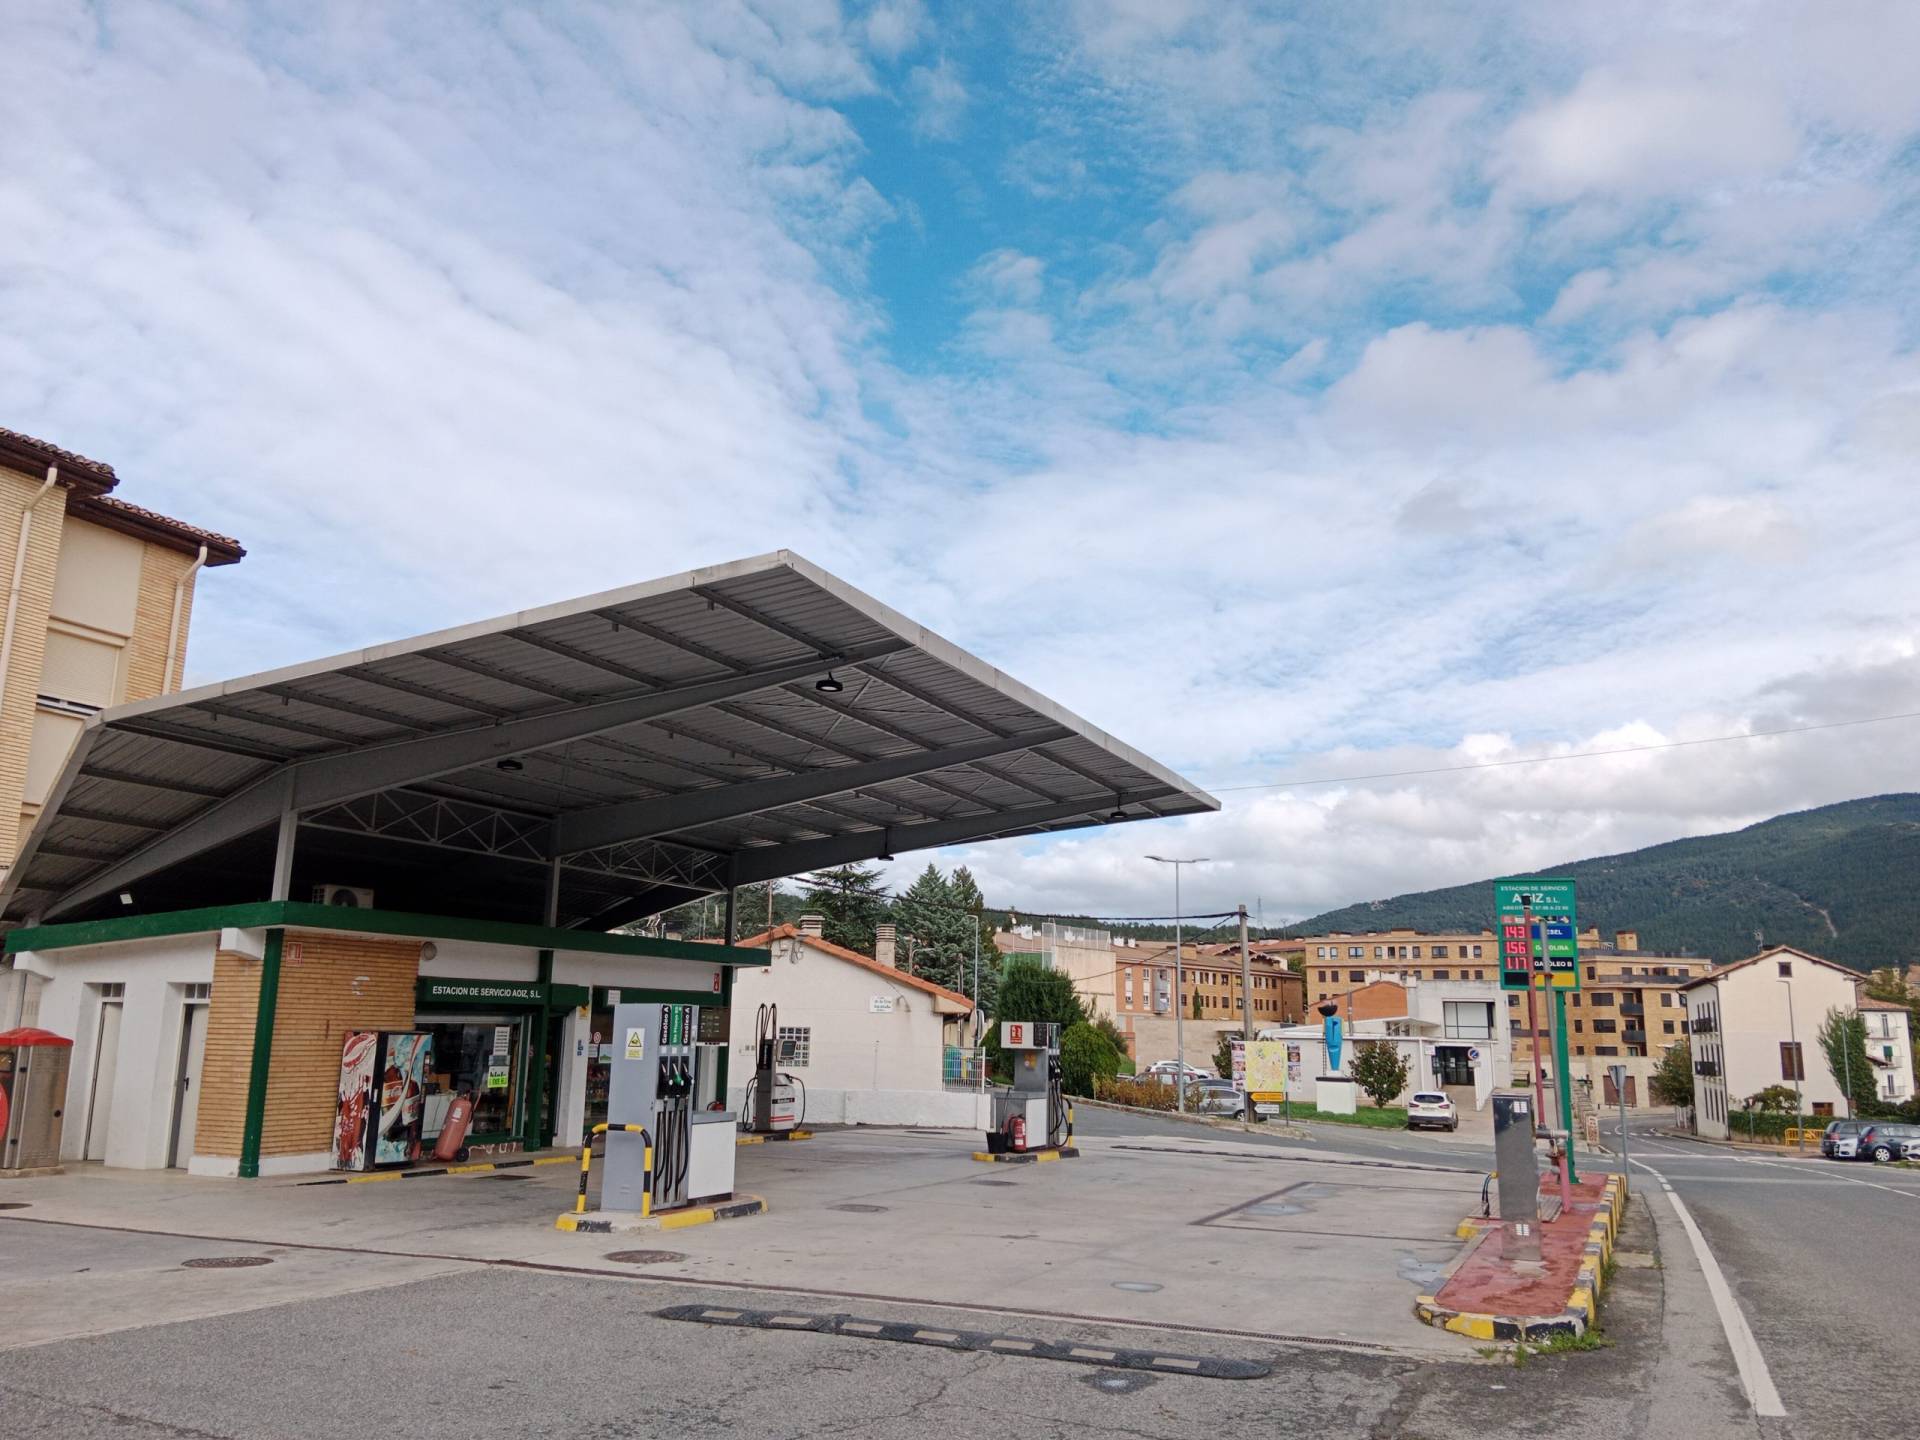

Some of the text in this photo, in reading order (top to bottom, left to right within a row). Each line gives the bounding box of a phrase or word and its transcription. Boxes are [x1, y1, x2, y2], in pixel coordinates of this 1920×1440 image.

[432, 985, 468, 995] ESTACION
[469, 987, 480, 996] DE
[480, 987, 512, 997] SERVICIO
